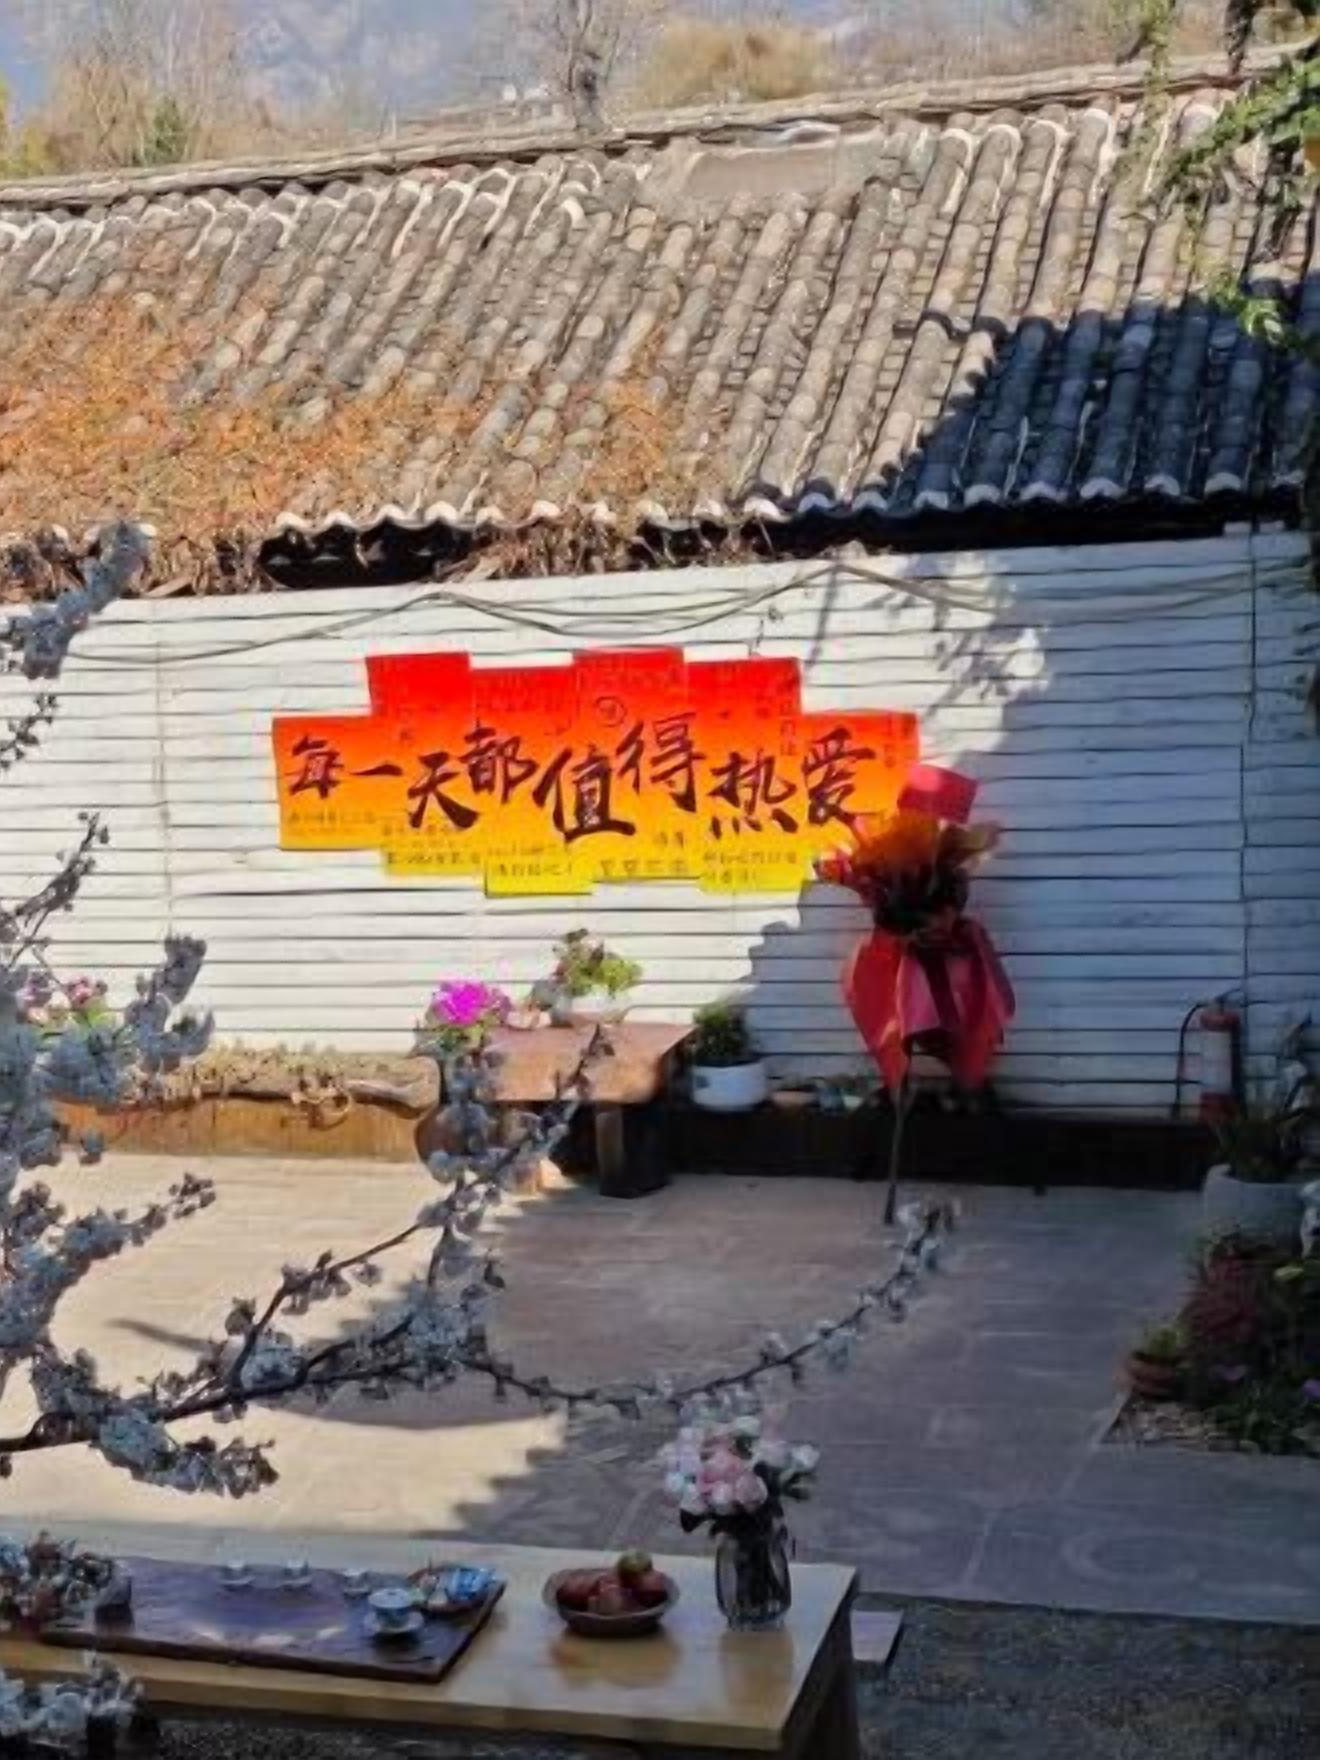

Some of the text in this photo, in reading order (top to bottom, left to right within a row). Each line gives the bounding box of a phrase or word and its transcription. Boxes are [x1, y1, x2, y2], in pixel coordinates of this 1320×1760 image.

[284, 712, 877, 847] 每一天都值得热爱
